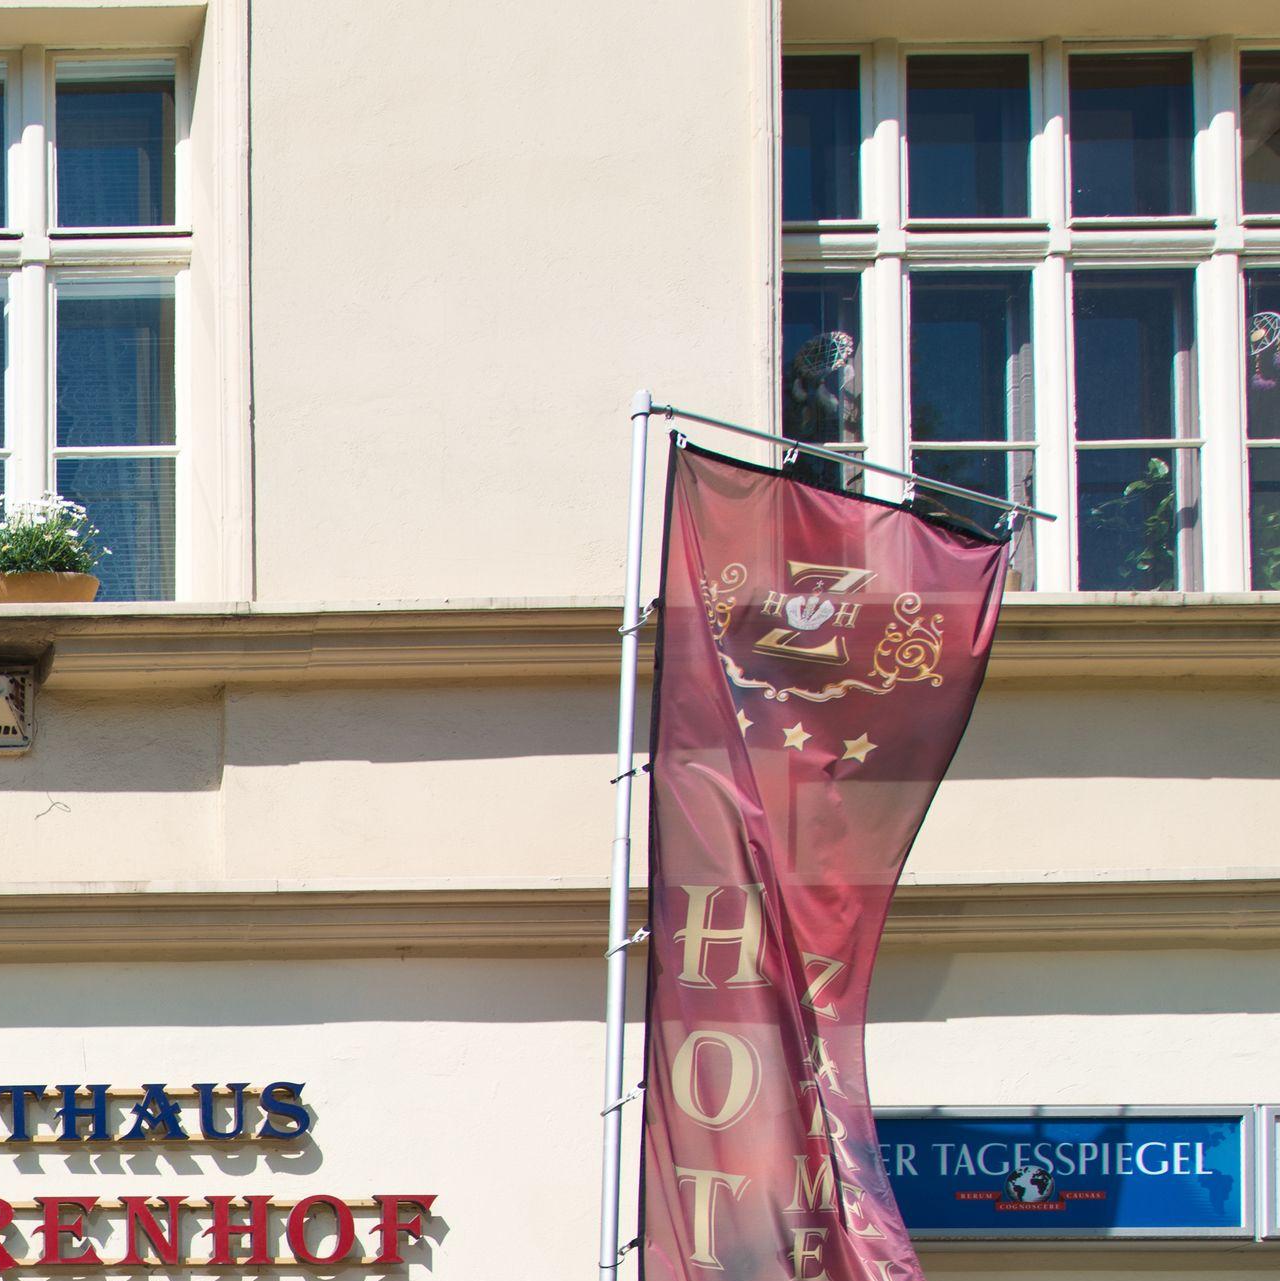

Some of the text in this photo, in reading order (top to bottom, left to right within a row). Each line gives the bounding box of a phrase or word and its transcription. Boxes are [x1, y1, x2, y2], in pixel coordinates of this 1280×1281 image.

[832, 602, 863, 628] H
[879, 1142, 1214, 1177] ER TAGESSPIEGEL
